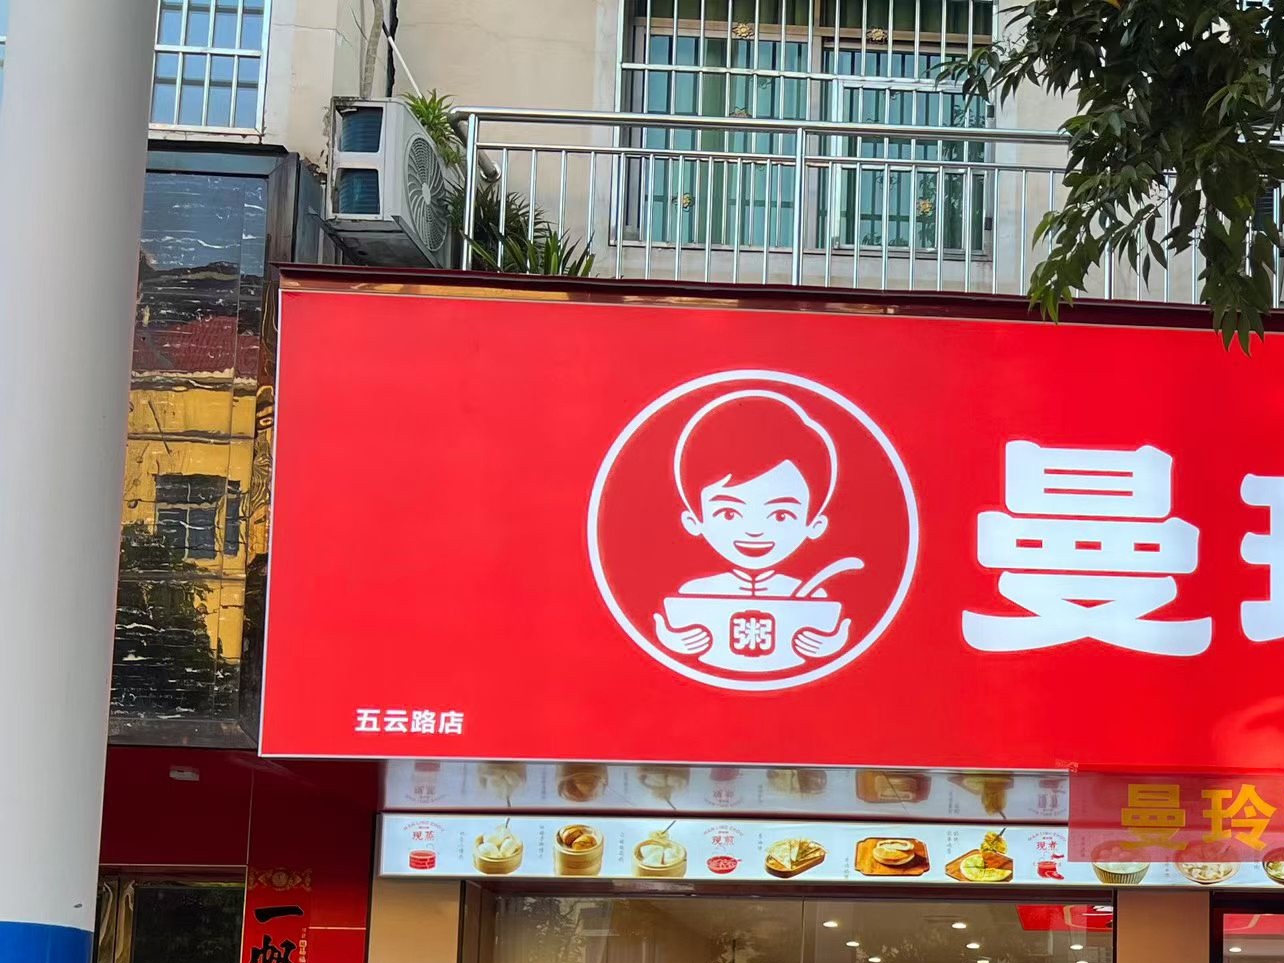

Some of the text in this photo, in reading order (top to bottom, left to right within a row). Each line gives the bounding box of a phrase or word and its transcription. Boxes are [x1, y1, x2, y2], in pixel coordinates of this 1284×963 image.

[733, 616, 772, 651] 粥
[355, 707, 466, 736] 五云路店
